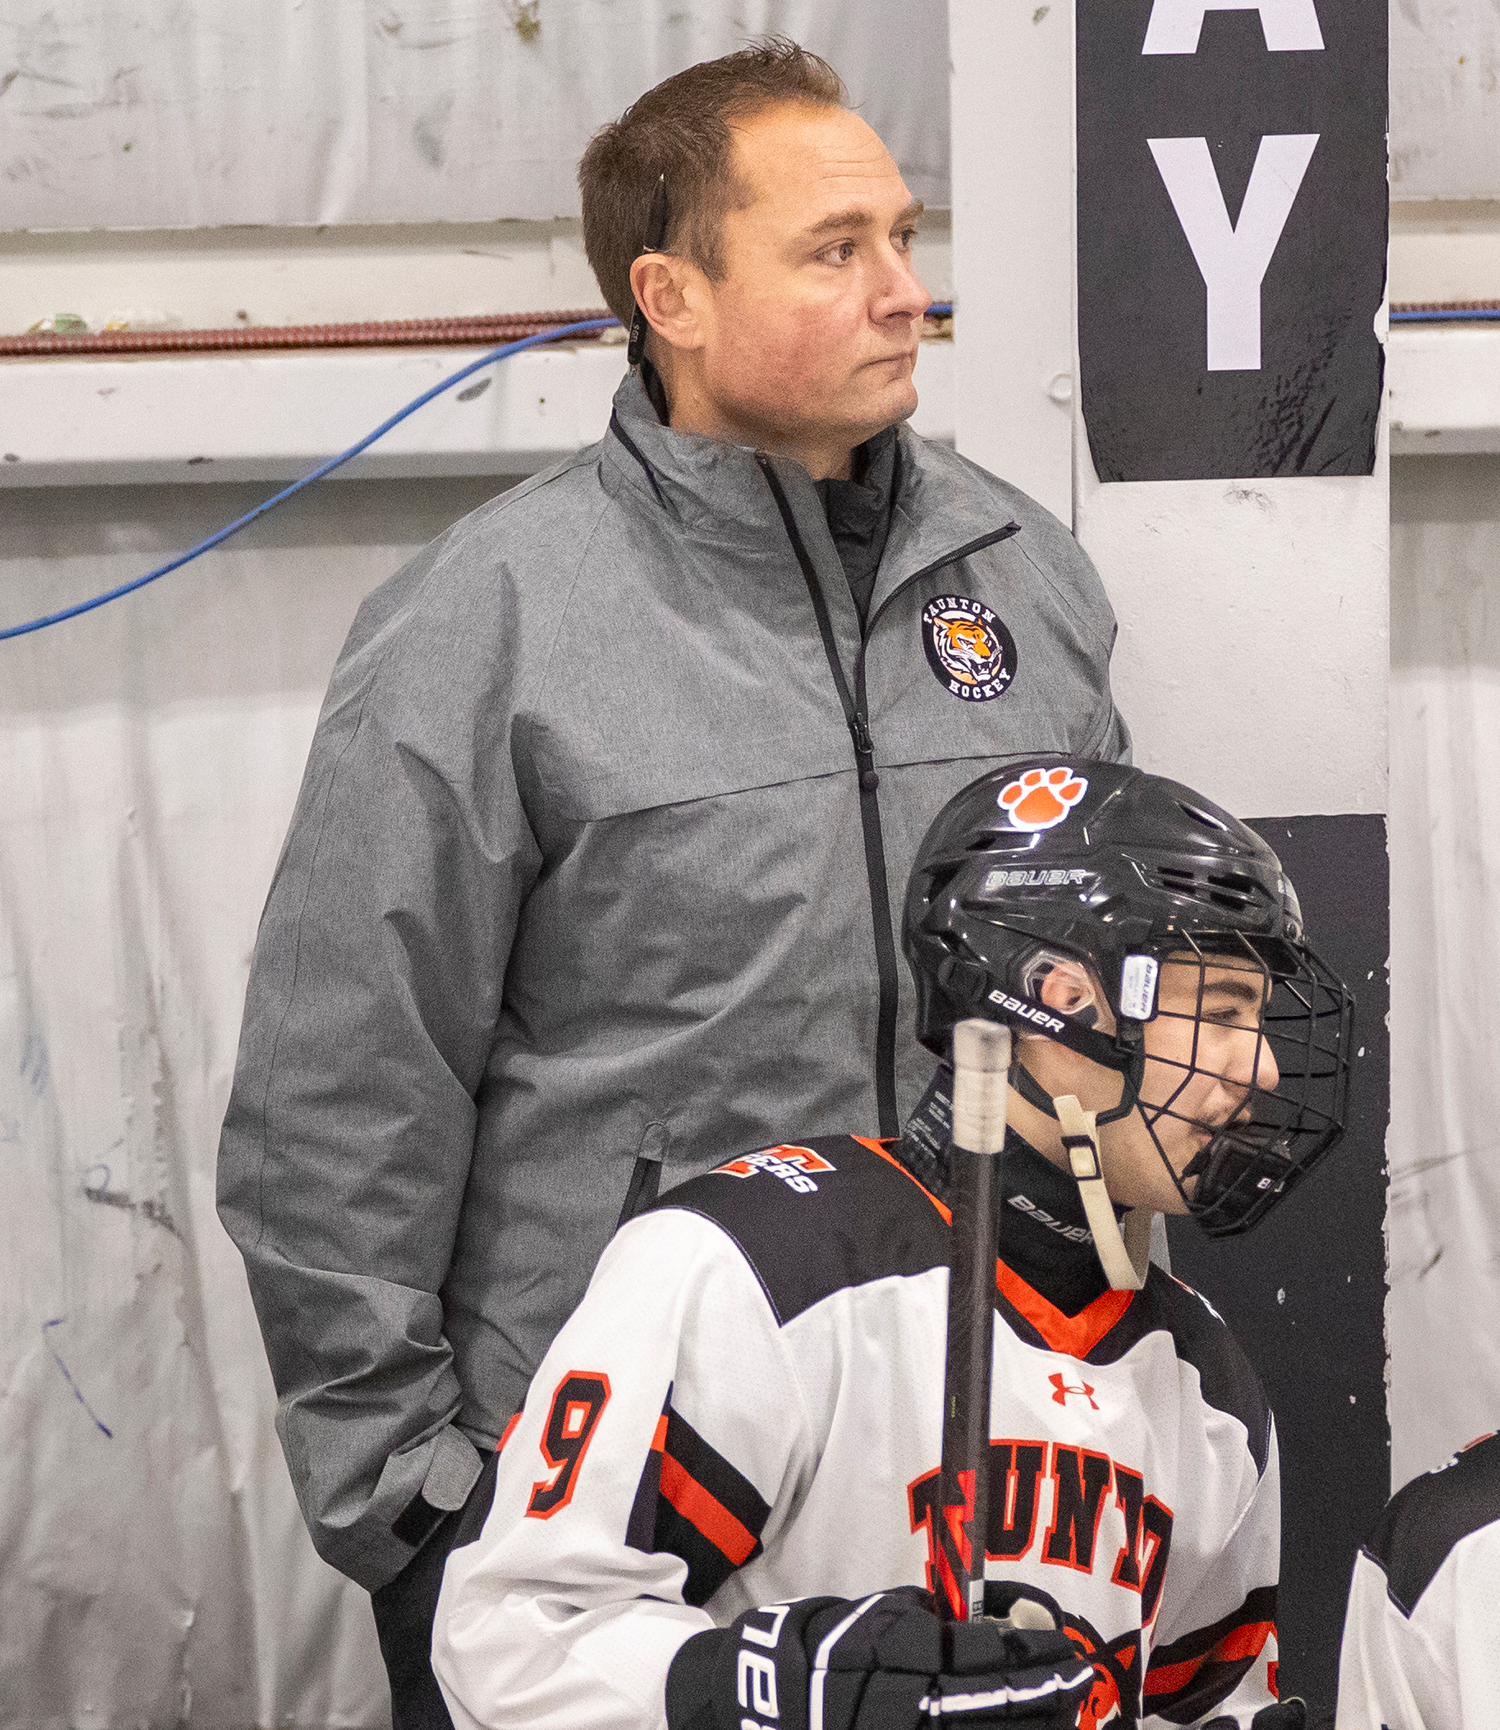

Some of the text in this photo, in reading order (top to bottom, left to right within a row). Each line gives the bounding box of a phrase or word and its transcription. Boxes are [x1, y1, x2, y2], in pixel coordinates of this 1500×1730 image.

[923, 597, 996, 624] TAUNTON
[949, 668, 1010, 699] HOCKEY
[523, 1369, 613, 1521] 9
